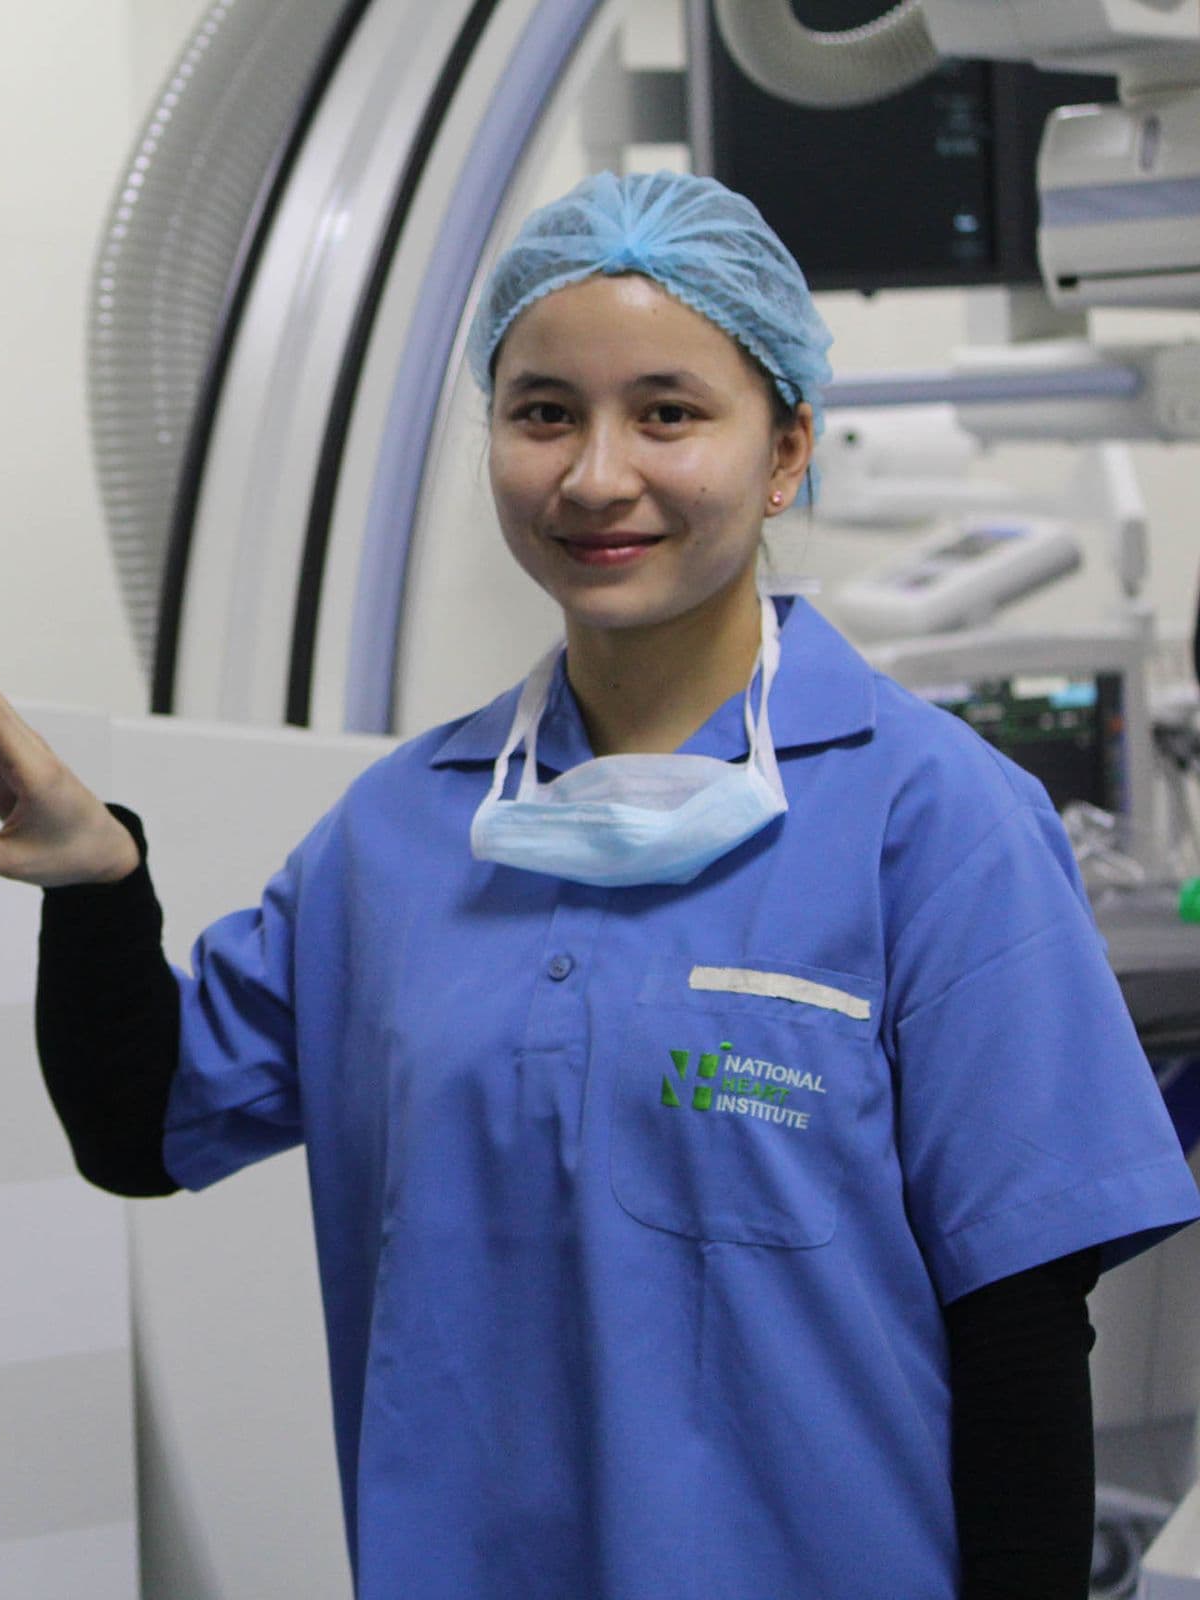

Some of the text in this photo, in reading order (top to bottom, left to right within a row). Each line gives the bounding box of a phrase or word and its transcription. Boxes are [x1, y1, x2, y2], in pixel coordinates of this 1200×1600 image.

[721, 1075, 790, 1104] HEART
[724, 1054, 827, 1093] NATIONAL
[715, 1094, 811, 1130] INSTITUTE
